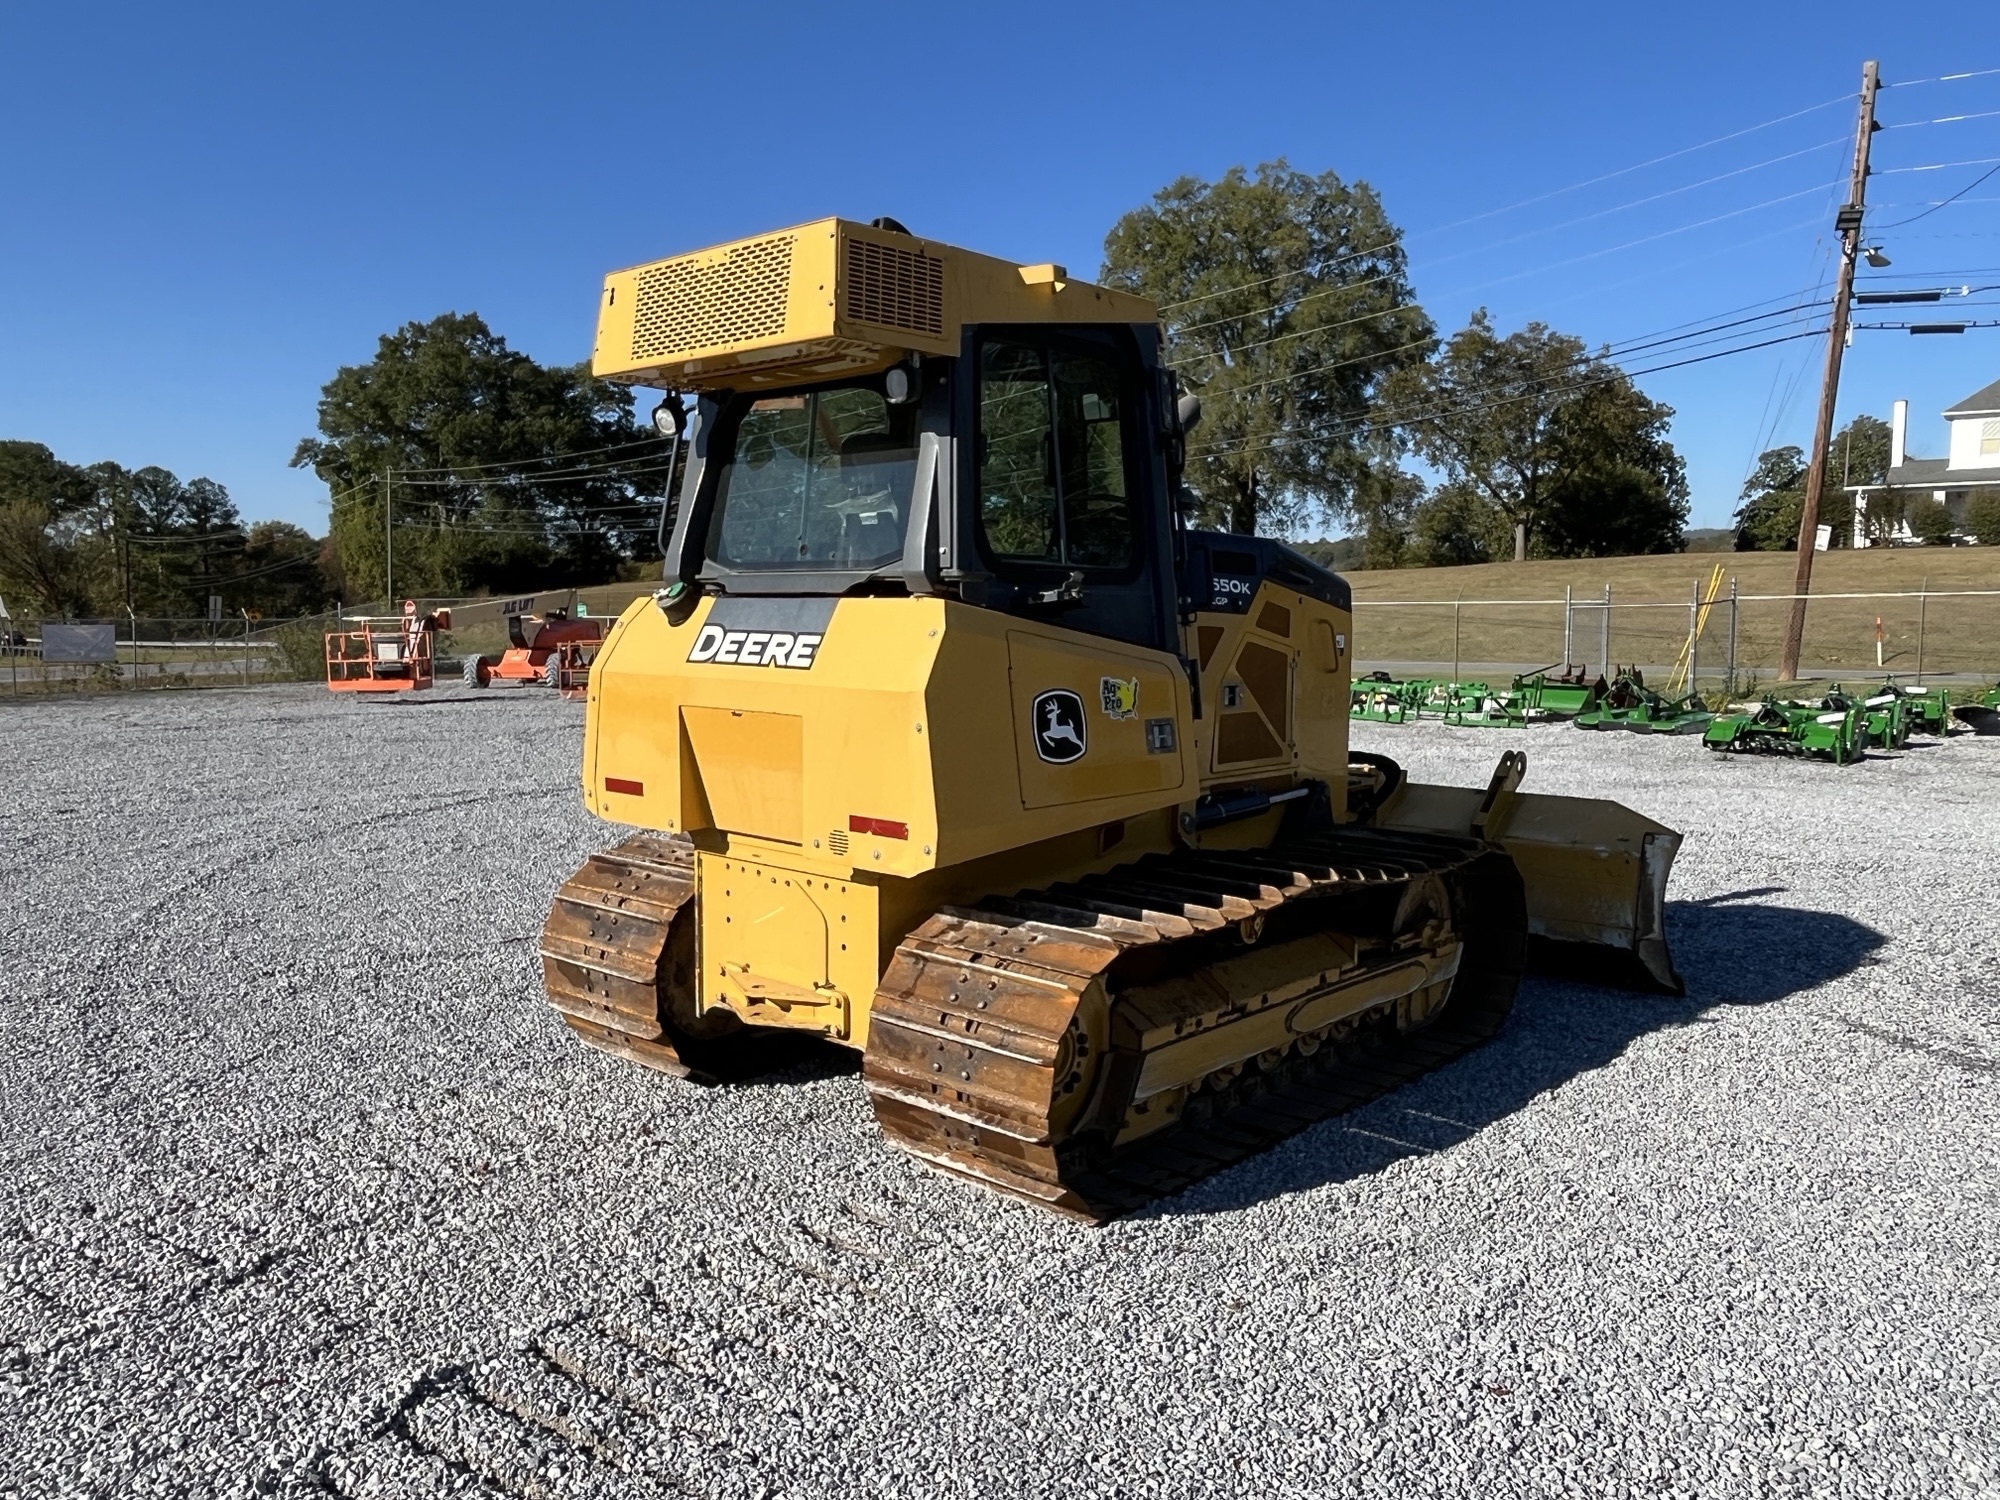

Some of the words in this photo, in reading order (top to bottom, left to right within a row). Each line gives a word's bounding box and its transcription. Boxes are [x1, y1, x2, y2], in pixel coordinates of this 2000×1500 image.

[518, 598, 535, 612] LIFT
[688, 625, 822, 668] DEERE
[1102, 679, 1117, 698] Ag
[1103, 695, 1122, 711] Pro
